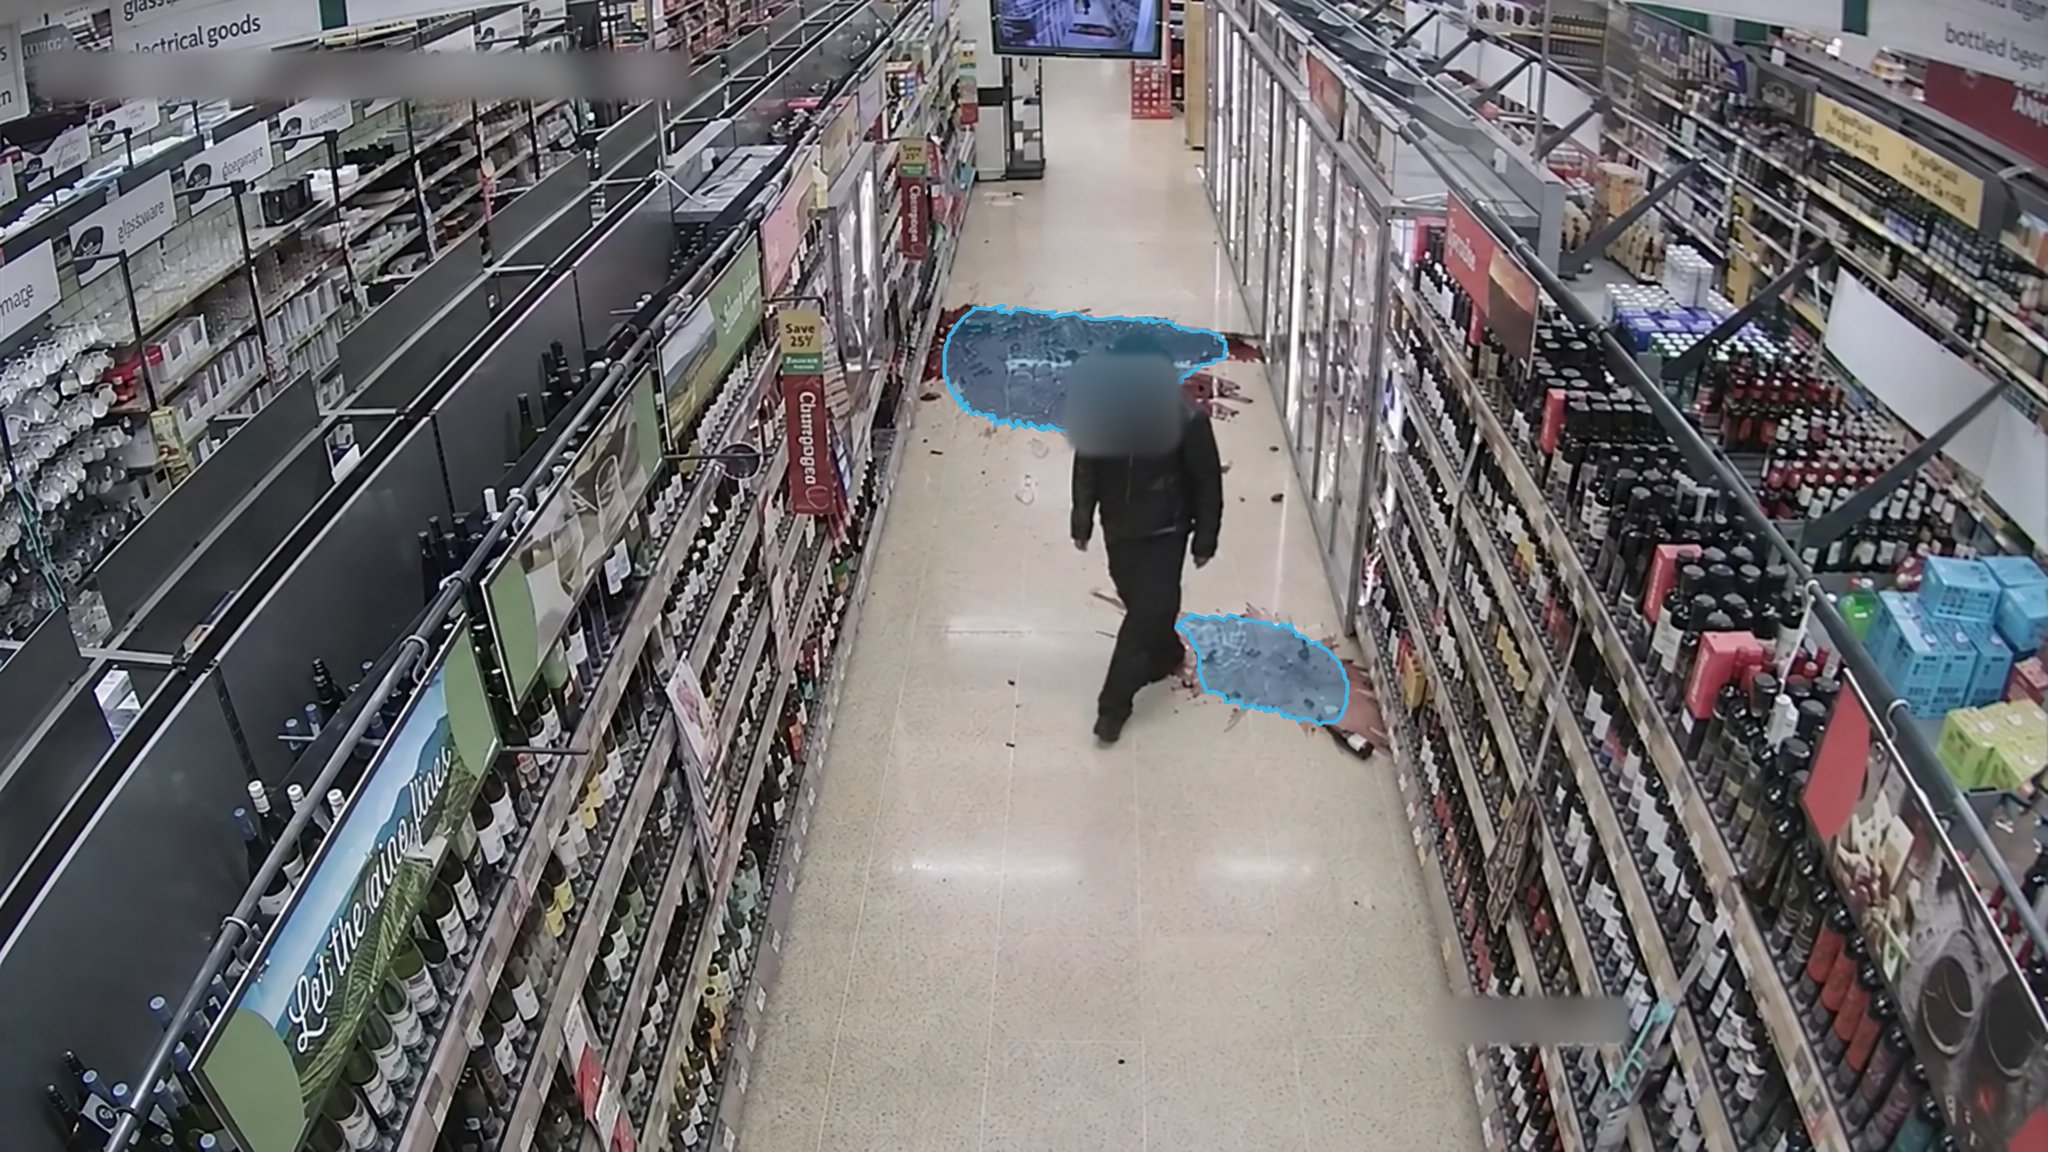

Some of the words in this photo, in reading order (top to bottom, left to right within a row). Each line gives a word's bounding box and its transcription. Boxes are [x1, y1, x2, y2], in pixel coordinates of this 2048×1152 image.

[206, 13, 261, 48] goods
[1945, 21, 2006, 58] bottled
[785, 323, 815, 334] Save
[288, 952, 334, 1054] Let
[328, 902, 368, 976] the
